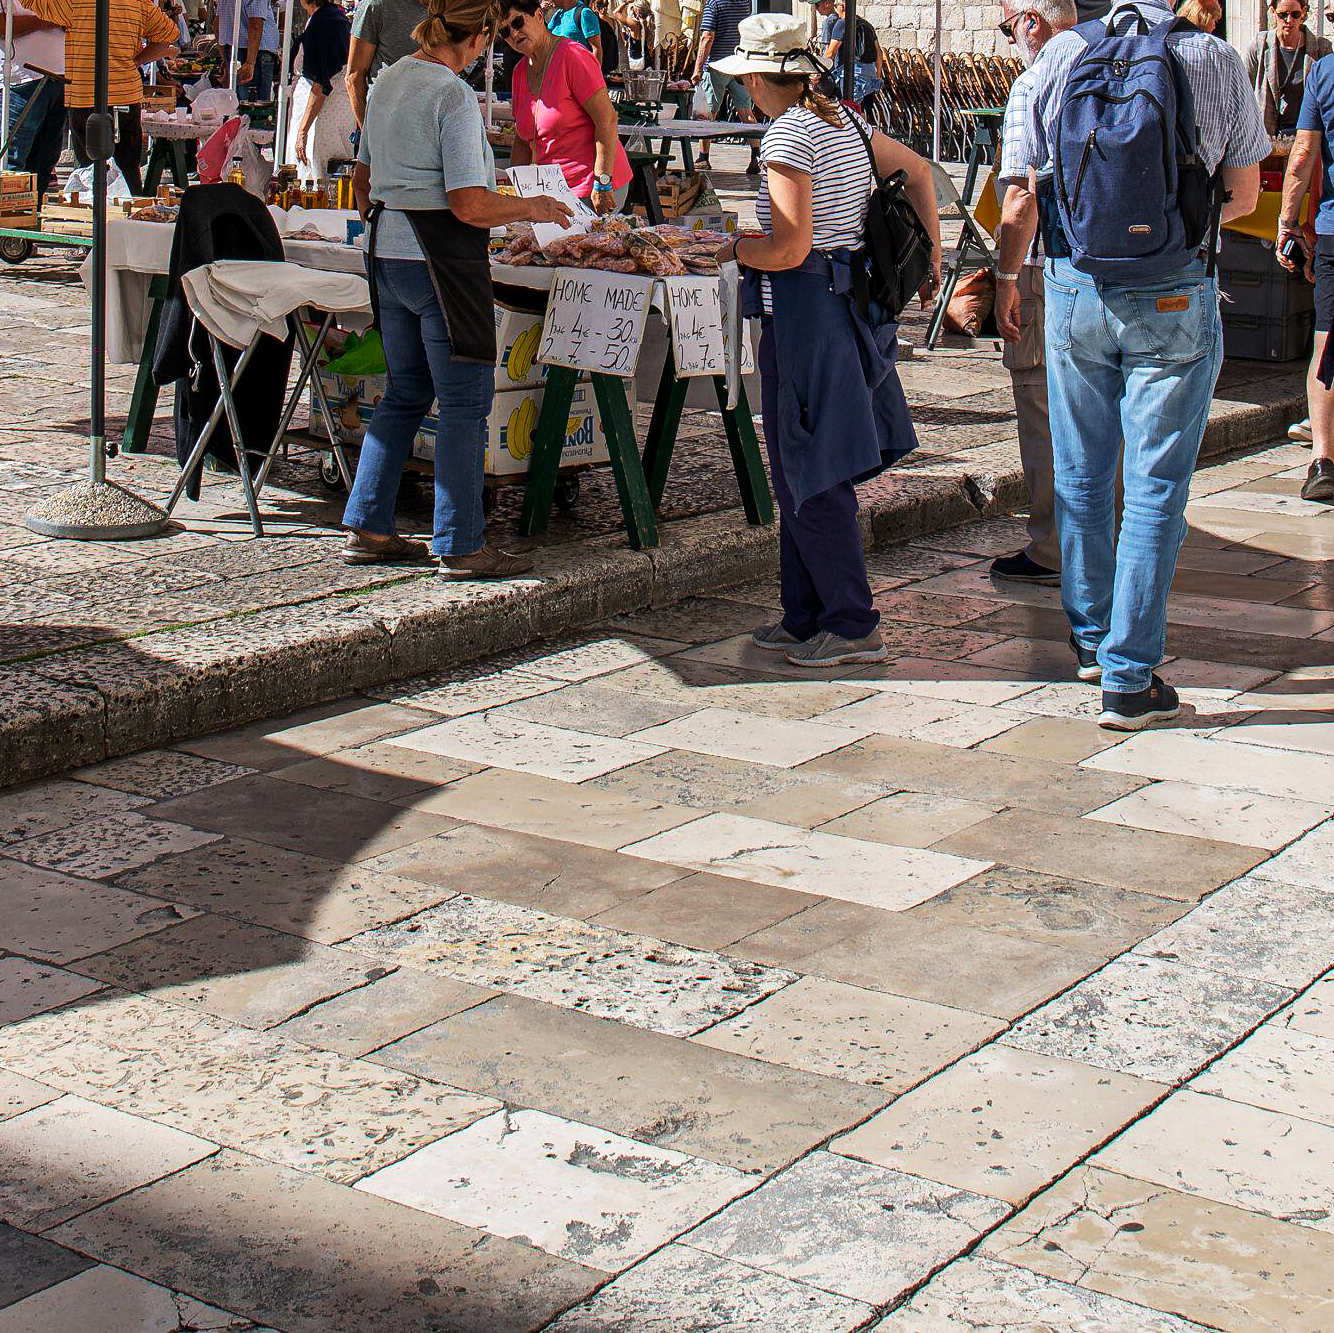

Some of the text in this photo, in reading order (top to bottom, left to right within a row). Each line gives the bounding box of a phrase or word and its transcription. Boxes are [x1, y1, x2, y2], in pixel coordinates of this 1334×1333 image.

[553, 278, 644, 311] HOME MADE
[671, 287, 703, 307] HOME
